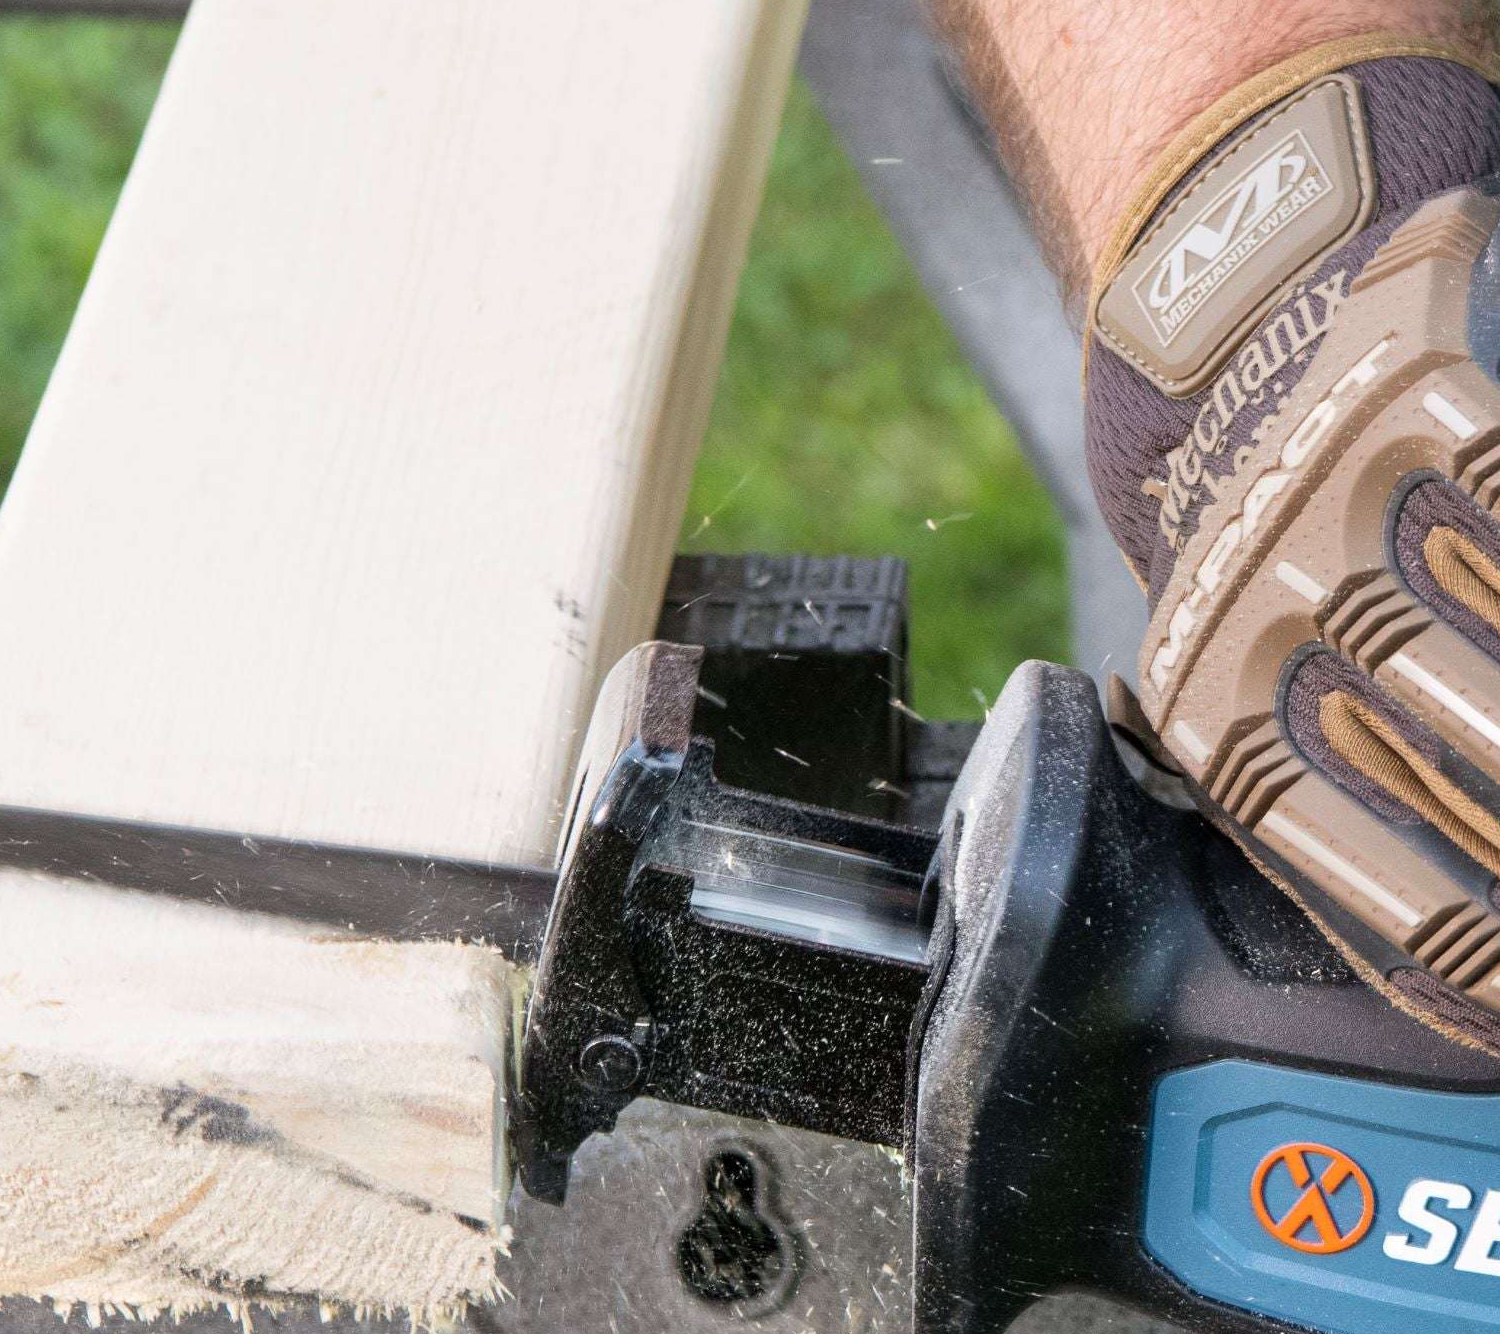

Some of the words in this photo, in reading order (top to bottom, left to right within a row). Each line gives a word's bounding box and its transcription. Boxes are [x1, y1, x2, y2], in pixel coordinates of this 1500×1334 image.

[1160, 232, 1260, 336] MECHANIX
[1258, 176, 1322, 235] WEAR
[1150, 338, 1390, 694] M-PACT
